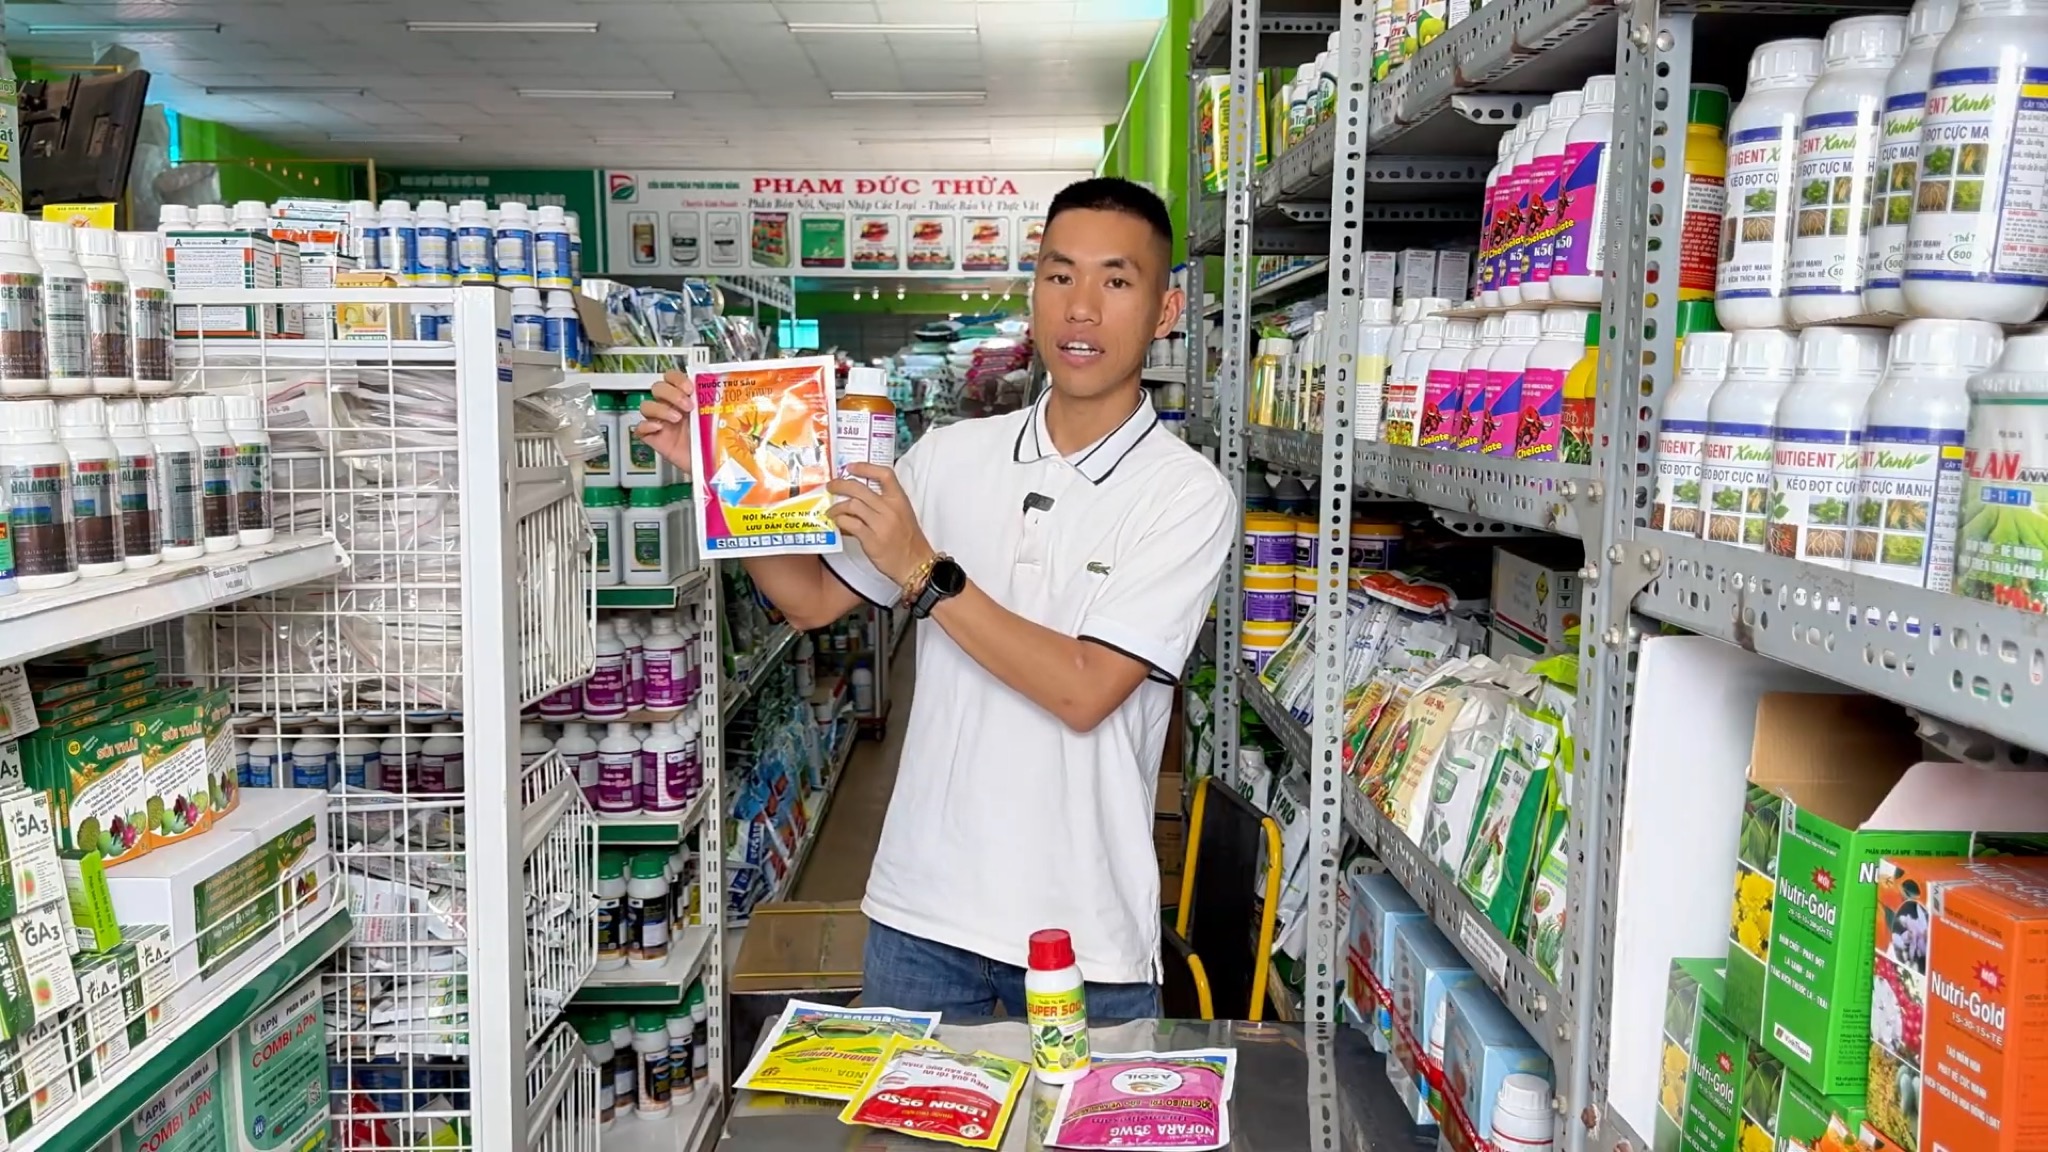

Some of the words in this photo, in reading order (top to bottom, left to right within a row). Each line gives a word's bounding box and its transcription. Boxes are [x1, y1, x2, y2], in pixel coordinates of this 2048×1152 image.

[1948, 93, 1995, 115] Xanh
[1944, 125, 1968, 140] CỰC
[1882, 147, 1899, 161] CỰC
[1819, 162, 1840, 174] CỰC
[753, 178, 844, 197] PHẠM
[855, 175, 921, 195] ĐỨC
[932, 175, 1019, 195] THỪA
[1953, 250, 1972, 260] 500
[740, 378, 756, 386] SÂU
[1420, 433, 1450, 447] Chelate
[1516, 443, 1553, 459] Chelate
[1775, 449, 1837, 469] NUTIGENT
[1874, 450, 1917, 470] Xanh
[1674, 464, 1688, 476] ĐỌT
[1713, 470, 1729, 483] ĐỌT
[1731, 470, 1754, 484] CỰC
[11, 480, 56, 494] BALANCE
[1786, 475, 1807, 490] KÉO
[1809, 478, 1831, 494] ĐỌT
[1872, 481, 1893, 495] CỰC
[1896, 482, 1933, 498] MẠNH
[742, 513, 758, 522] NỘI
[1779, 876, 1836, 926] Nutri-Gold
[25, 921, 61, 947] GA3
[1931, 971, 2006, 1031] Nutri-Gold
[1029, 1004, 1057, 1017] SUPER
[252, 1029, 293, 1069] COMBI
[296, 1012, 317, 1037] APN
[1126, 1073, 1172, 1081] ASOIL
[1692, 1052, 1734, 1105] Nutri-Gold
[188, 1087, 212, 1115] APN
[877, 1092, 924, 1107] 95SP
[929, 1100, 988, 1118] LEDAN
[1109, 1123, 1151, 1137] 35WG
[1157, 1123, 1215, 1137] NOFARA
